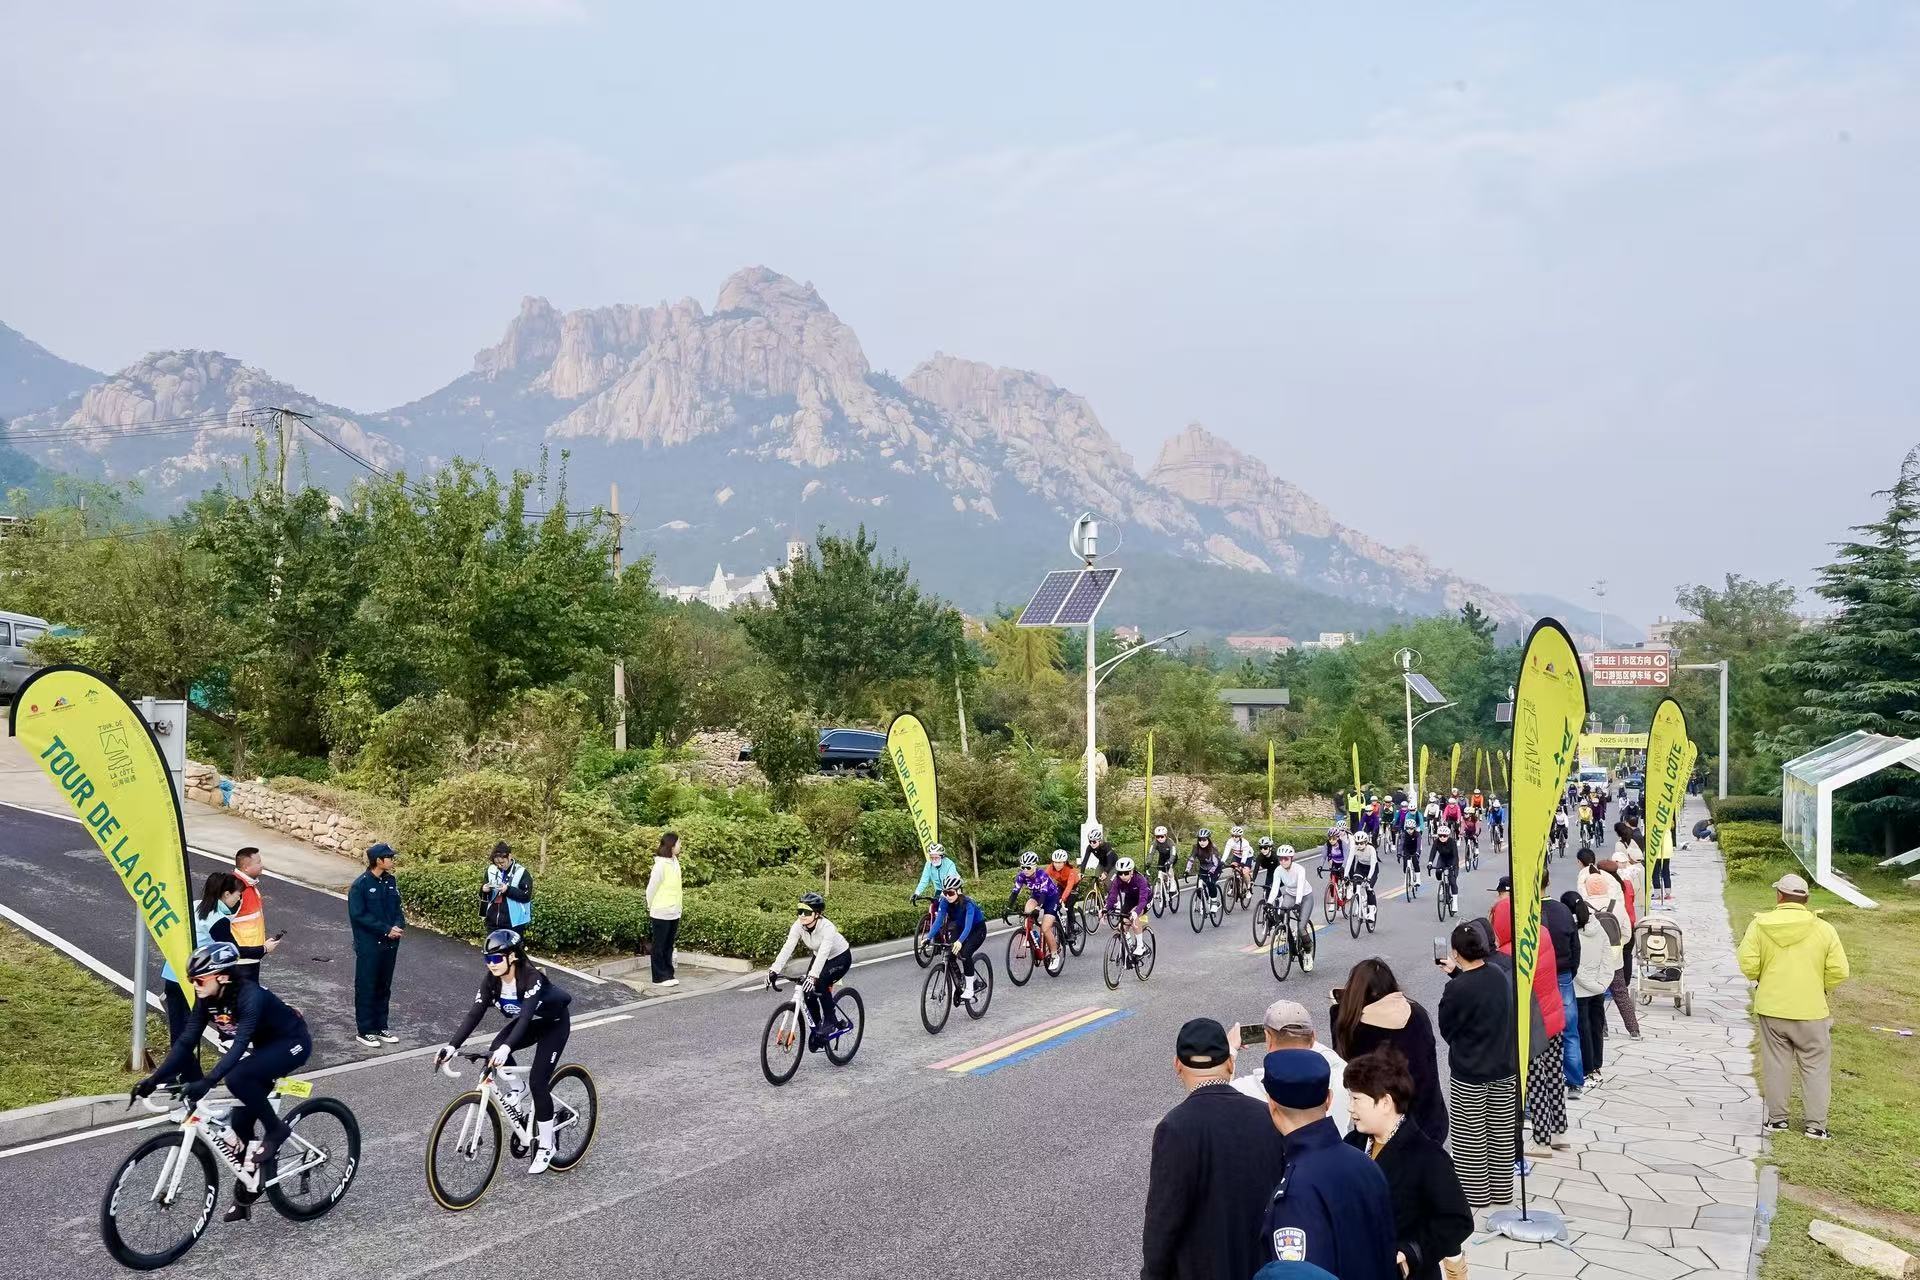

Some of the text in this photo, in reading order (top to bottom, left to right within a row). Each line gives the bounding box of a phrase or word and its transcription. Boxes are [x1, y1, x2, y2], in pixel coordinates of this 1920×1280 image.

[98, 719, 124, 732] TOUR DE
[110, 772, 118, 781] LA
[894, 746, 911, 781] TOUR
[905, 782, 918, 802] DE
[912, 799, 923, 820] LA
[1663, 780, 1675, 805] LA
[1656, 800, 1671, 827] DE
[41, 735, 95, 809] TOUR
[87, 801, 121, 844] DE
[111, 835, 141, 879] LA
[133, 871, 181, 938] CÔTE
[1649, 825, 1664, 864] OUR
